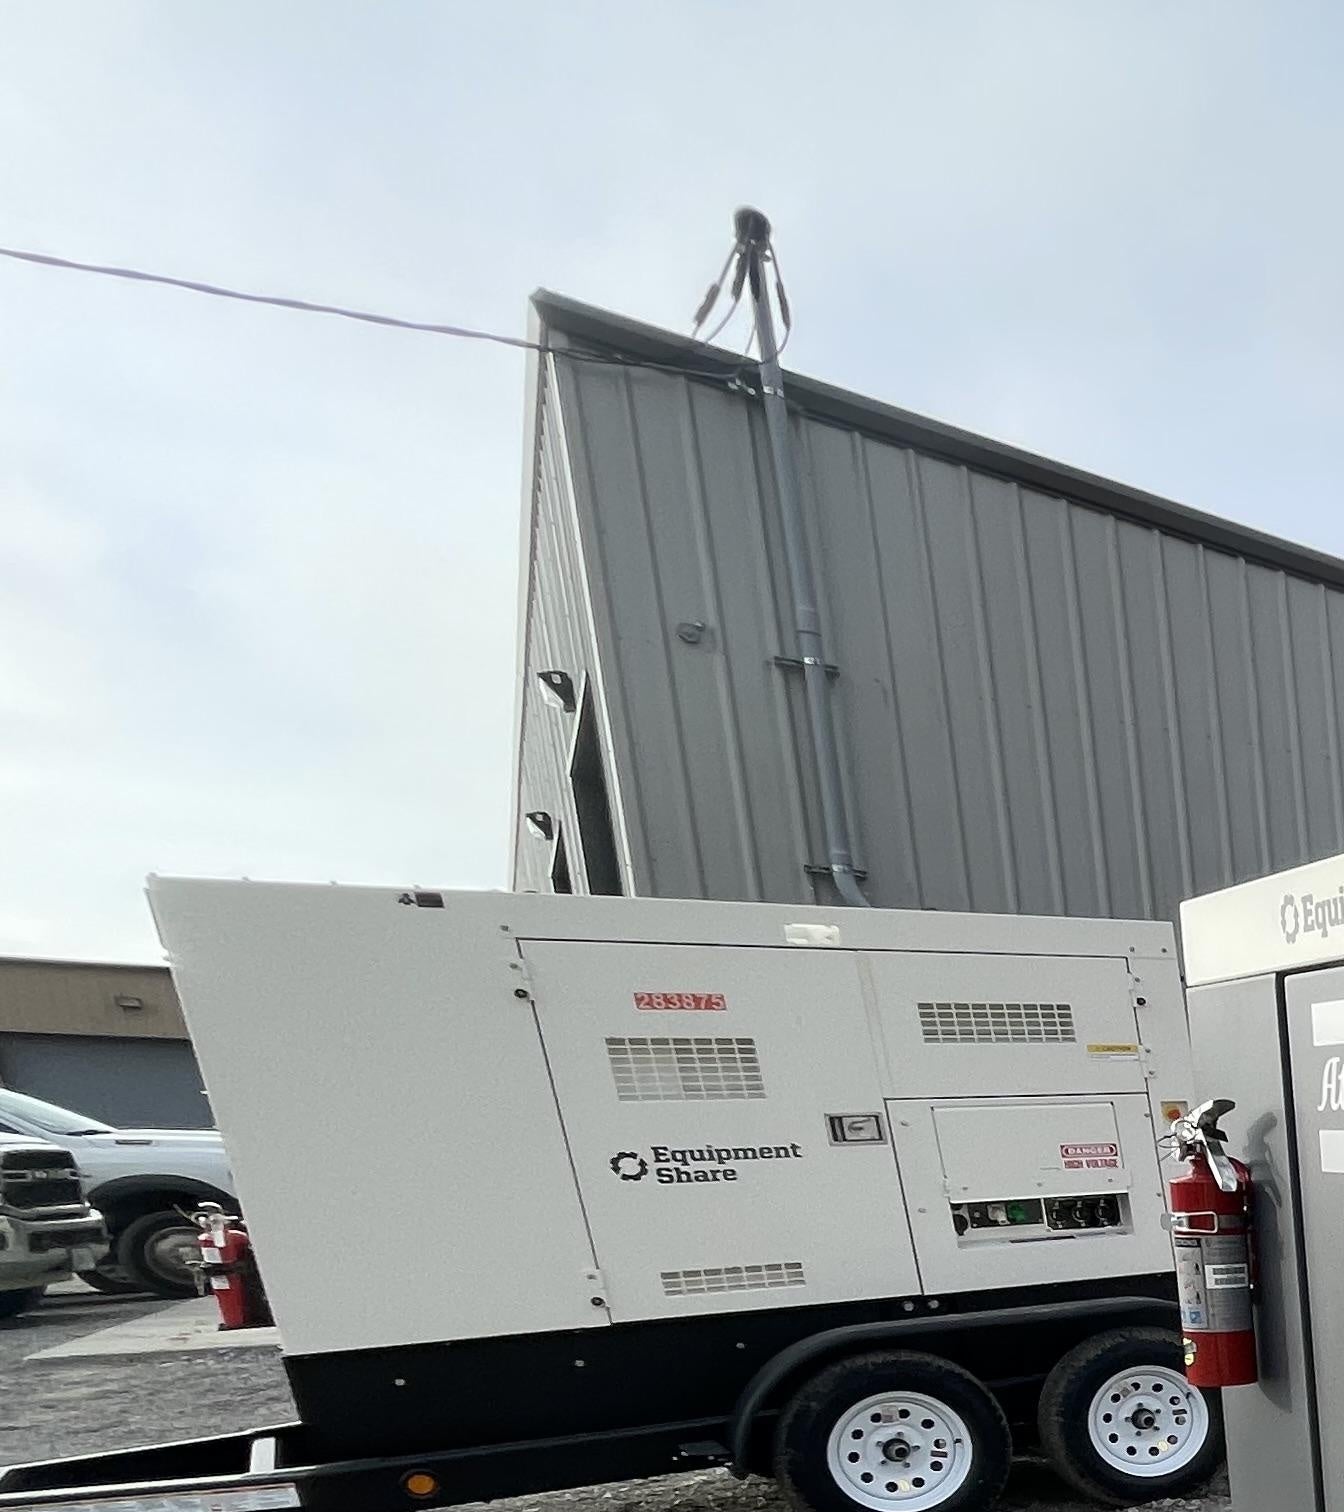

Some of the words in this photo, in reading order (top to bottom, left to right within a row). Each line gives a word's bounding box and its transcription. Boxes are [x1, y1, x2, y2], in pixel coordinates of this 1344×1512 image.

[636, 993, 726, 1010] 283875
[650, 1142, 803, 1166] Equipment
[655, 1167, 738, 1184] Share
